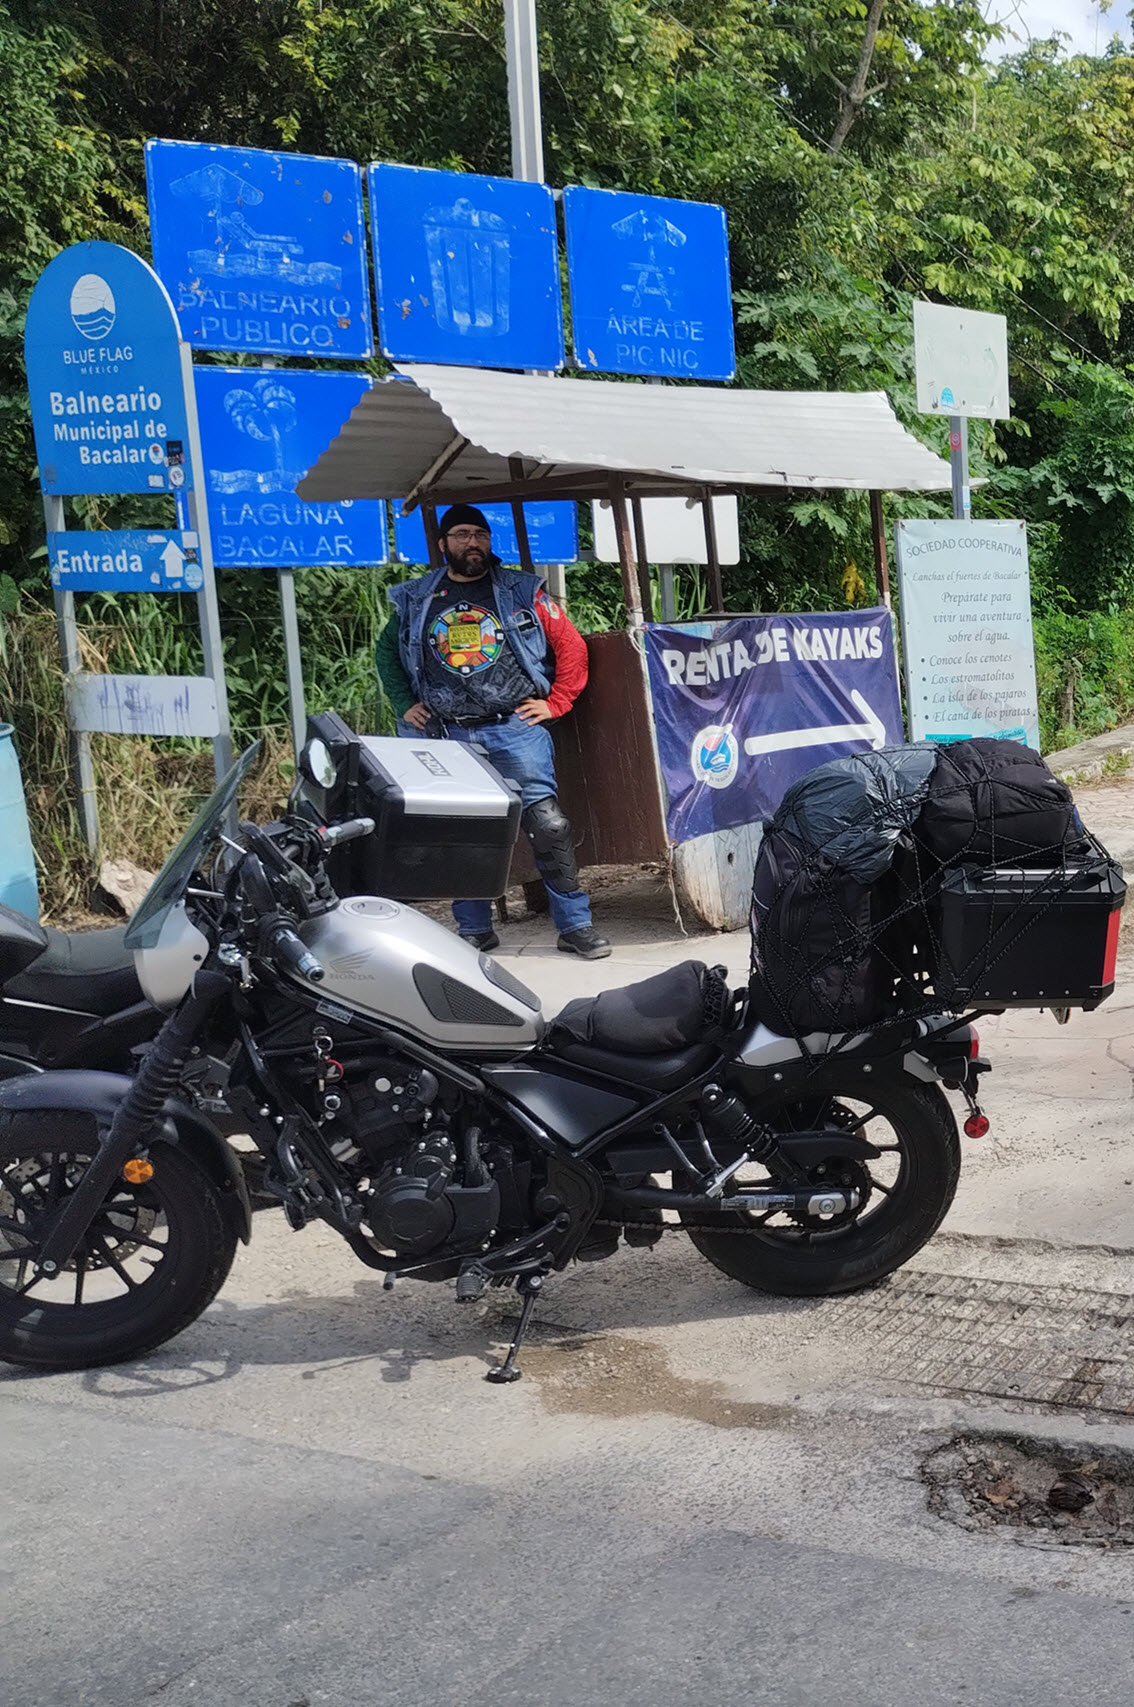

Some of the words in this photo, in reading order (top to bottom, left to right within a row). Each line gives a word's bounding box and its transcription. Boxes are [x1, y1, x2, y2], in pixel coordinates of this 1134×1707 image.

[179, 287, 350, 318] BALNEARIO
[201, 316, 334, 347] PUBLICO
[674, 320, 704, 341] DE
[63, 348, 96, 364] BLUE
[99, 346, 133, 362] FLAG
[616, 343, 654, 366] PIC
[661, 347, 699, 369] NIC
[50, 385, 162, 416] Balneario
[54, 420, 139, 444] Municipal
[145, 419, 167, 438] de
[79, 444, 147, 465] Bacalar
[221, 503, 344, 526] LAGUNA
[217, 535, 355, 557] BACALAR
[906, 538, 956, 558] SOCIEDAD
[958, 537, 1022, 557] COOPERATIVA
[57, 549, 143, 573] Entrada
[912, 571, 945, 581] Lanchas
[946, 570, 954, 581] el
[953, 570, 981, 583] fuertes
[982, 570, 992, 580] de
[993, 570, 1022, 580] Bacalar
[941, 591, 988, 606] Prepárate
[990, 593, 1012, 605] para
[933, 611, 956, 623] vivir
[959, 613, 977, 622] una
[980, 611, 1021, 622] aventura
[947, 630, 972, 642] sobre
[974, 628, 984, 642] el
[985, 632, 1010, 645] agua.
[662, 639, 757, 686] RENTA
[756, 627, 790, 665] DE
[792, 625, 883, 661] KAYAKS
[929, 654, 962, 667] Conoce
[965, 652, 978, 664] los
[980, 653, 1013, 663] cenotes
[931, 673, 949, 685] Los
[951, 669, 1015, 683] estromatolitos
[932, 692, 945, 703] La
[948, 689, 964, 702] isla
[966, 688, 977, 701] de
[980, 688, 993, 700] los
[934, 709, 947, 722] El
[971, 707, 982, 719] de
[984, 706, 998, 719] los
[999, 707, 1031, 721] piratas
